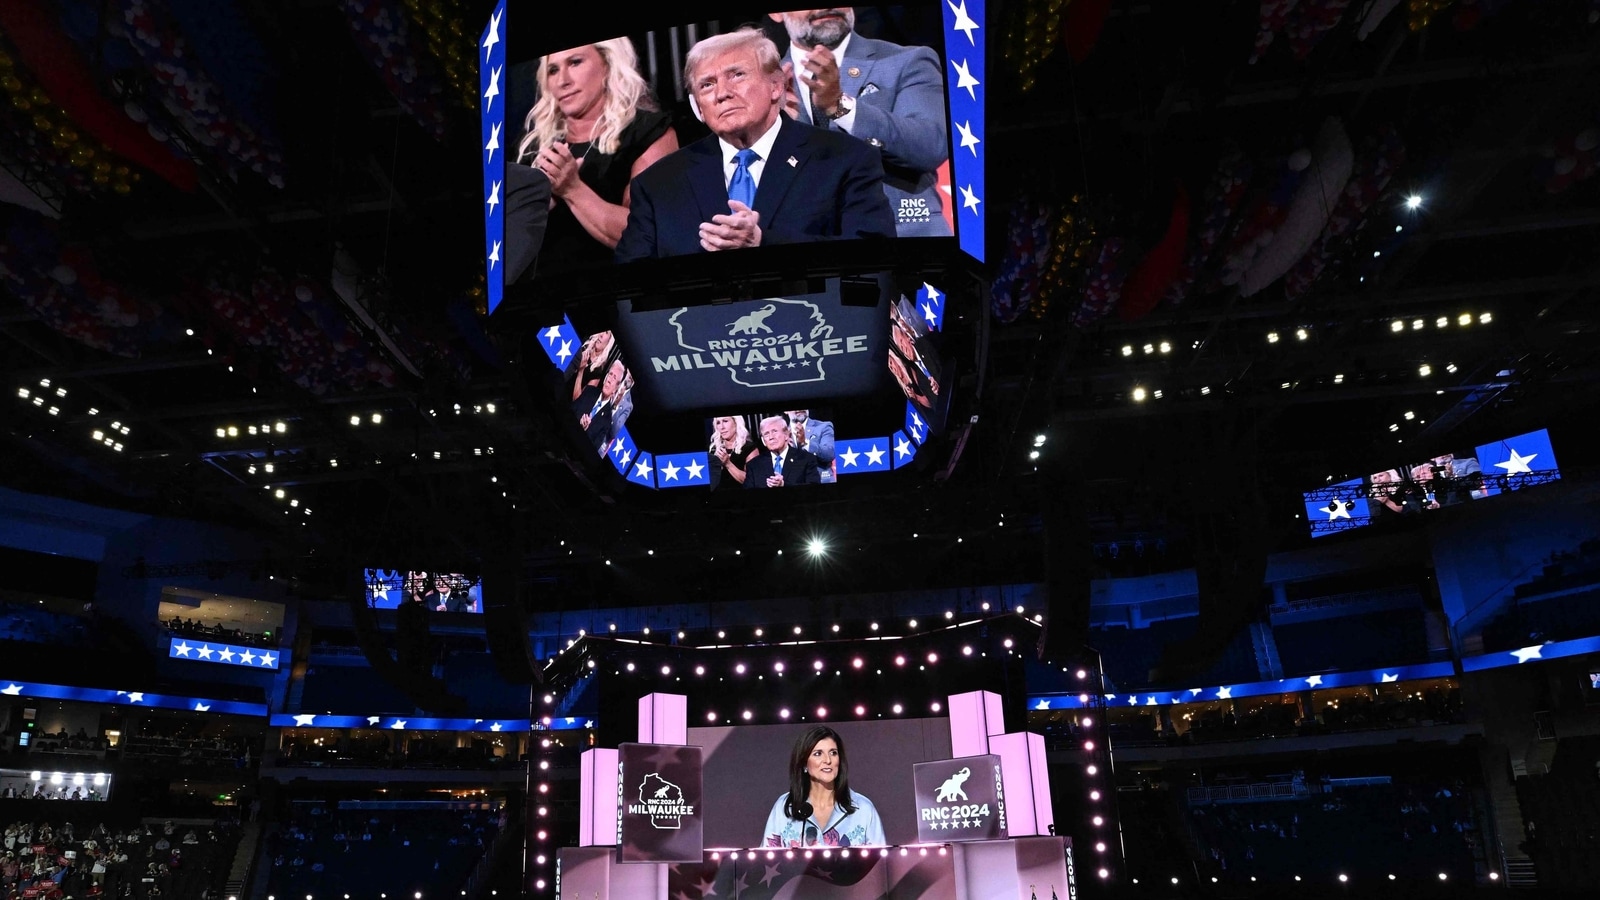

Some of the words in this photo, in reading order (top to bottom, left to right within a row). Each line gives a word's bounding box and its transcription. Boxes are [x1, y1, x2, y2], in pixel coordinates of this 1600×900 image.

[900, 198, 926, 207] RNC
[898, 207, 930, 217] 2024
[707, 337, 749, 350] RNC
[751, 332, 803, 347] 2024
[650, 334, 868, 372] MILWAUKEE
[994, 764, 1003, 800] 2024
[628, 804, 694, 815] MILWAUKEE
[921, 807, 950, 820] RNC
[951, 803, 990, 819] 2024
[998, 801, 1006, 829] RNC
[1066, 846, 1075, 884] 2024
